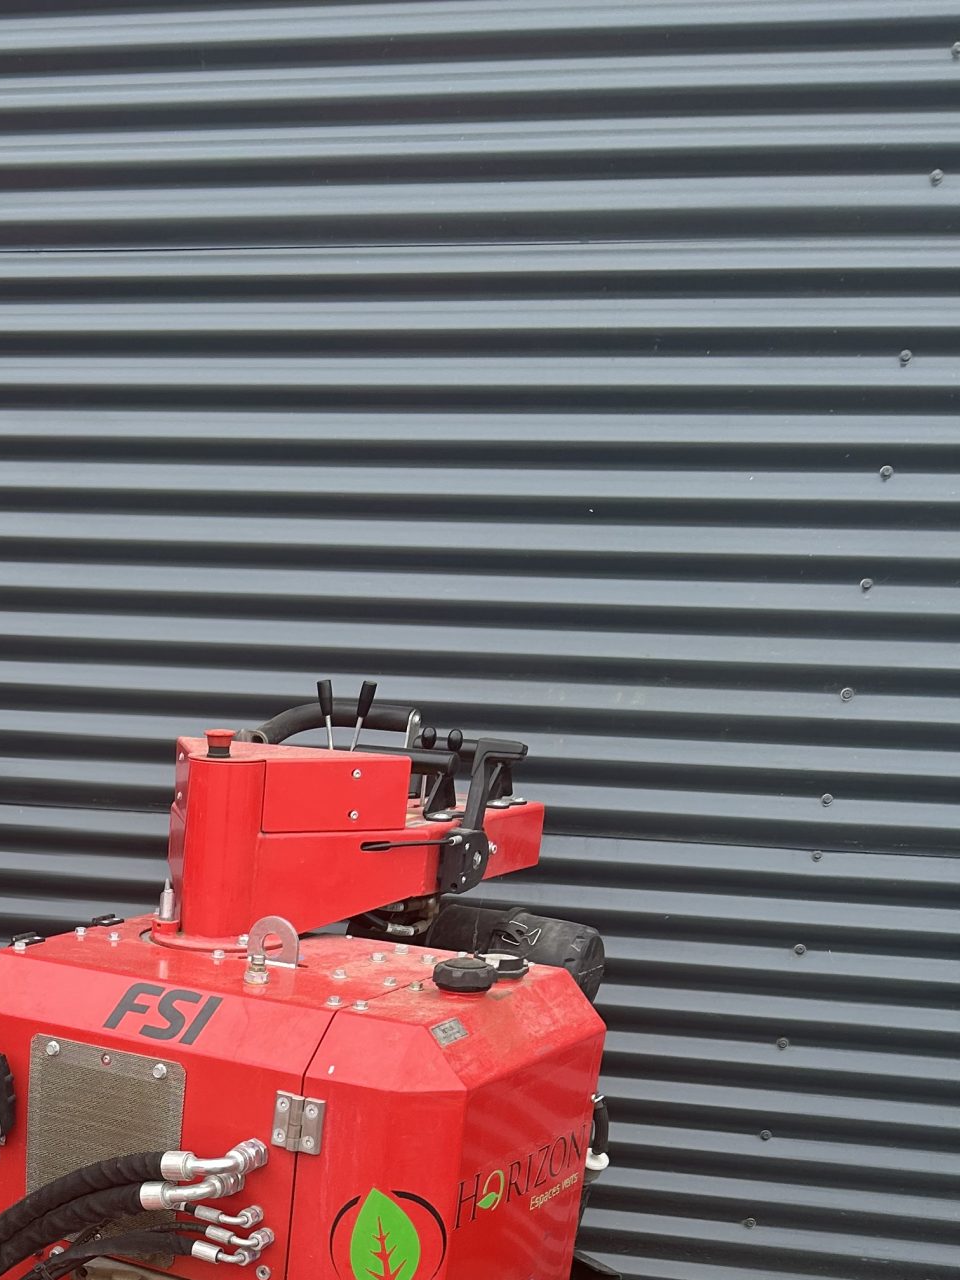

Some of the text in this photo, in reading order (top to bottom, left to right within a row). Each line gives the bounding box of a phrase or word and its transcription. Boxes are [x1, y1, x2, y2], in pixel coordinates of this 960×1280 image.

[102, 982, 223, 1045] FSI
[452, 1123, 587, 1231] HORIZON
[529, 1184, 560, 1211] Espaces
